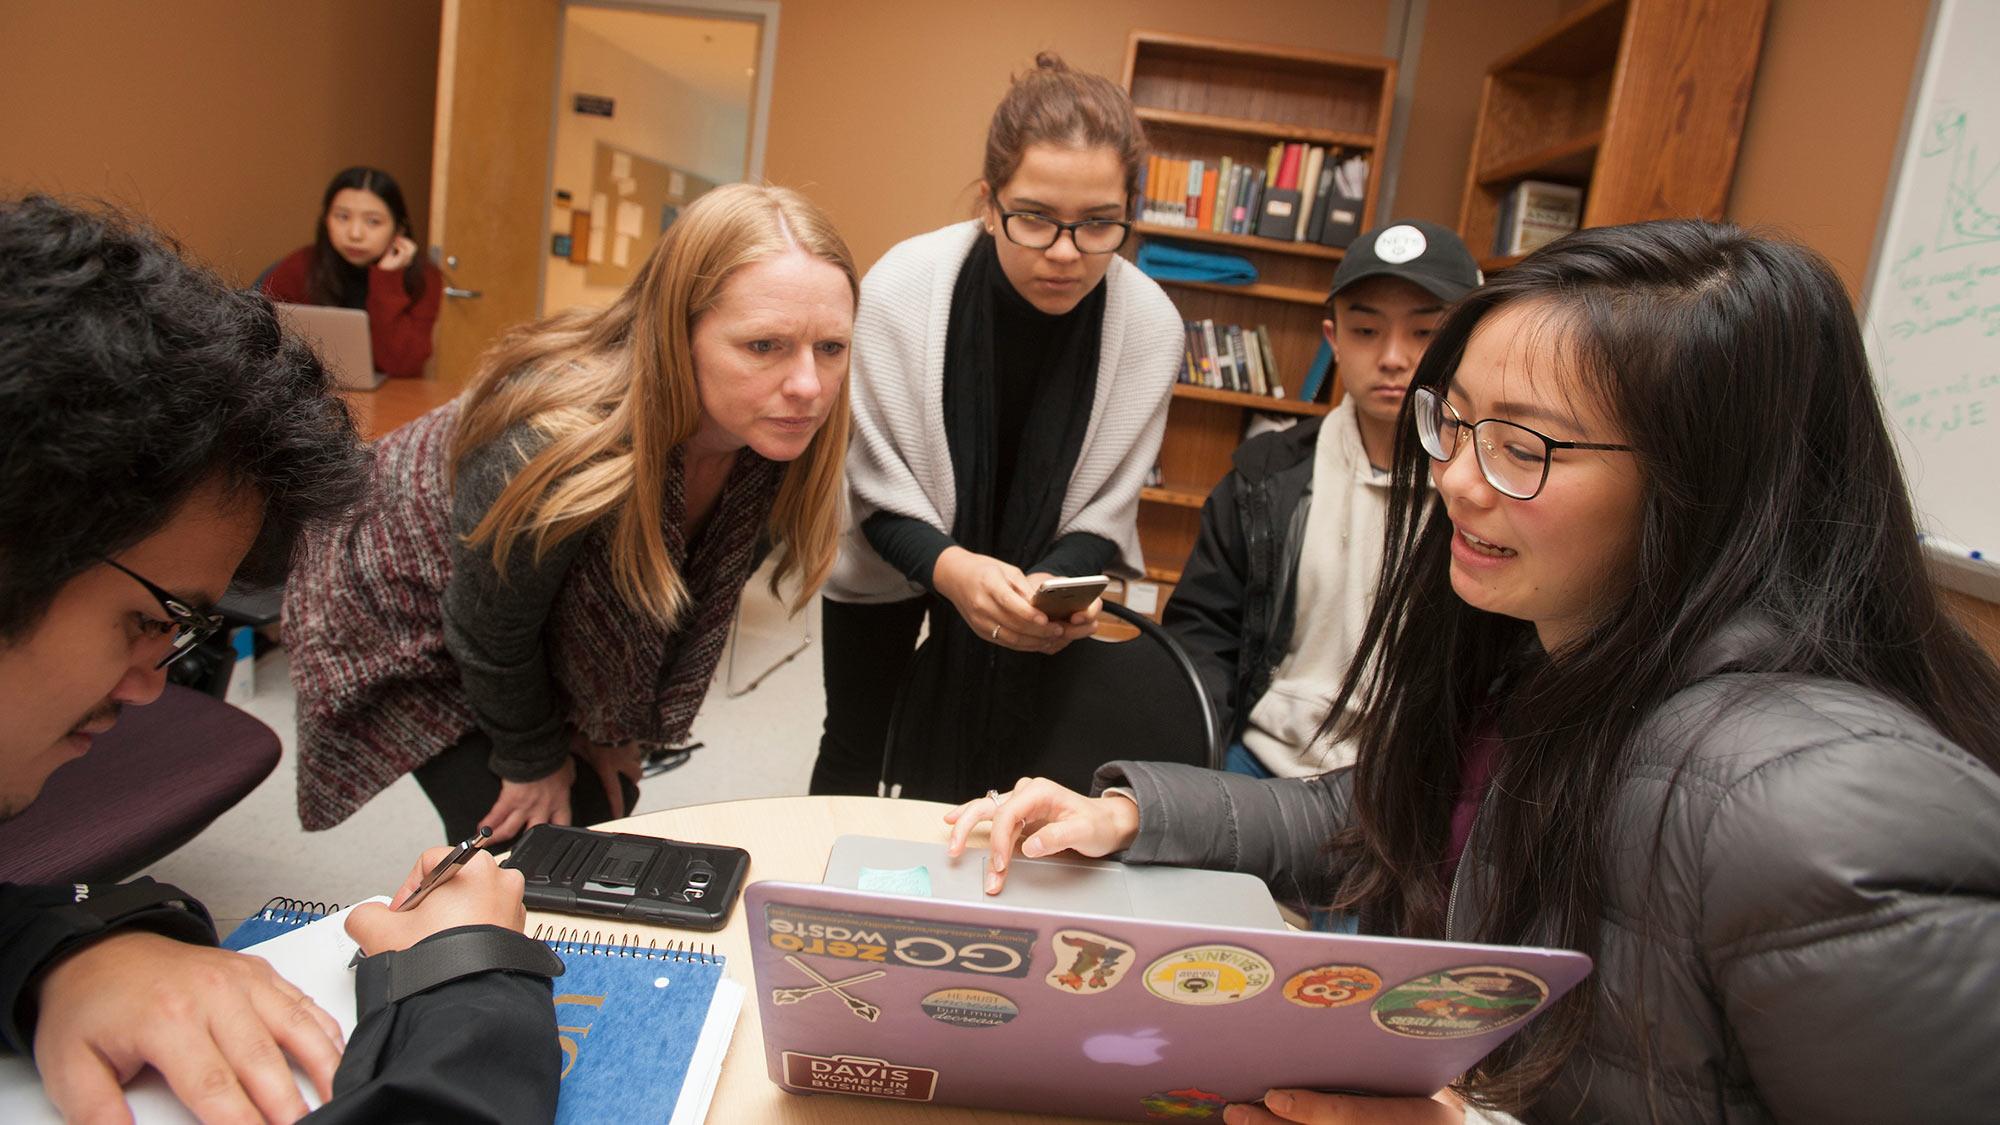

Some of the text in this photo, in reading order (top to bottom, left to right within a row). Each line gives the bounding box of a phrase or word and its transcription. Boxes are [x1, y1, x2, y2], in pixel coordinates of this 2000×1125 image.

[769, 919, 887, 945] waste
[770, 933, 888, 962] zero
[894, 937, 1022, 973] GO
[811, 1060, 909, 1081] DAVIS
[811, 1072, 908, 1090] WOMEN IN
[811, 1079, 906, 1096] BUSINESS
